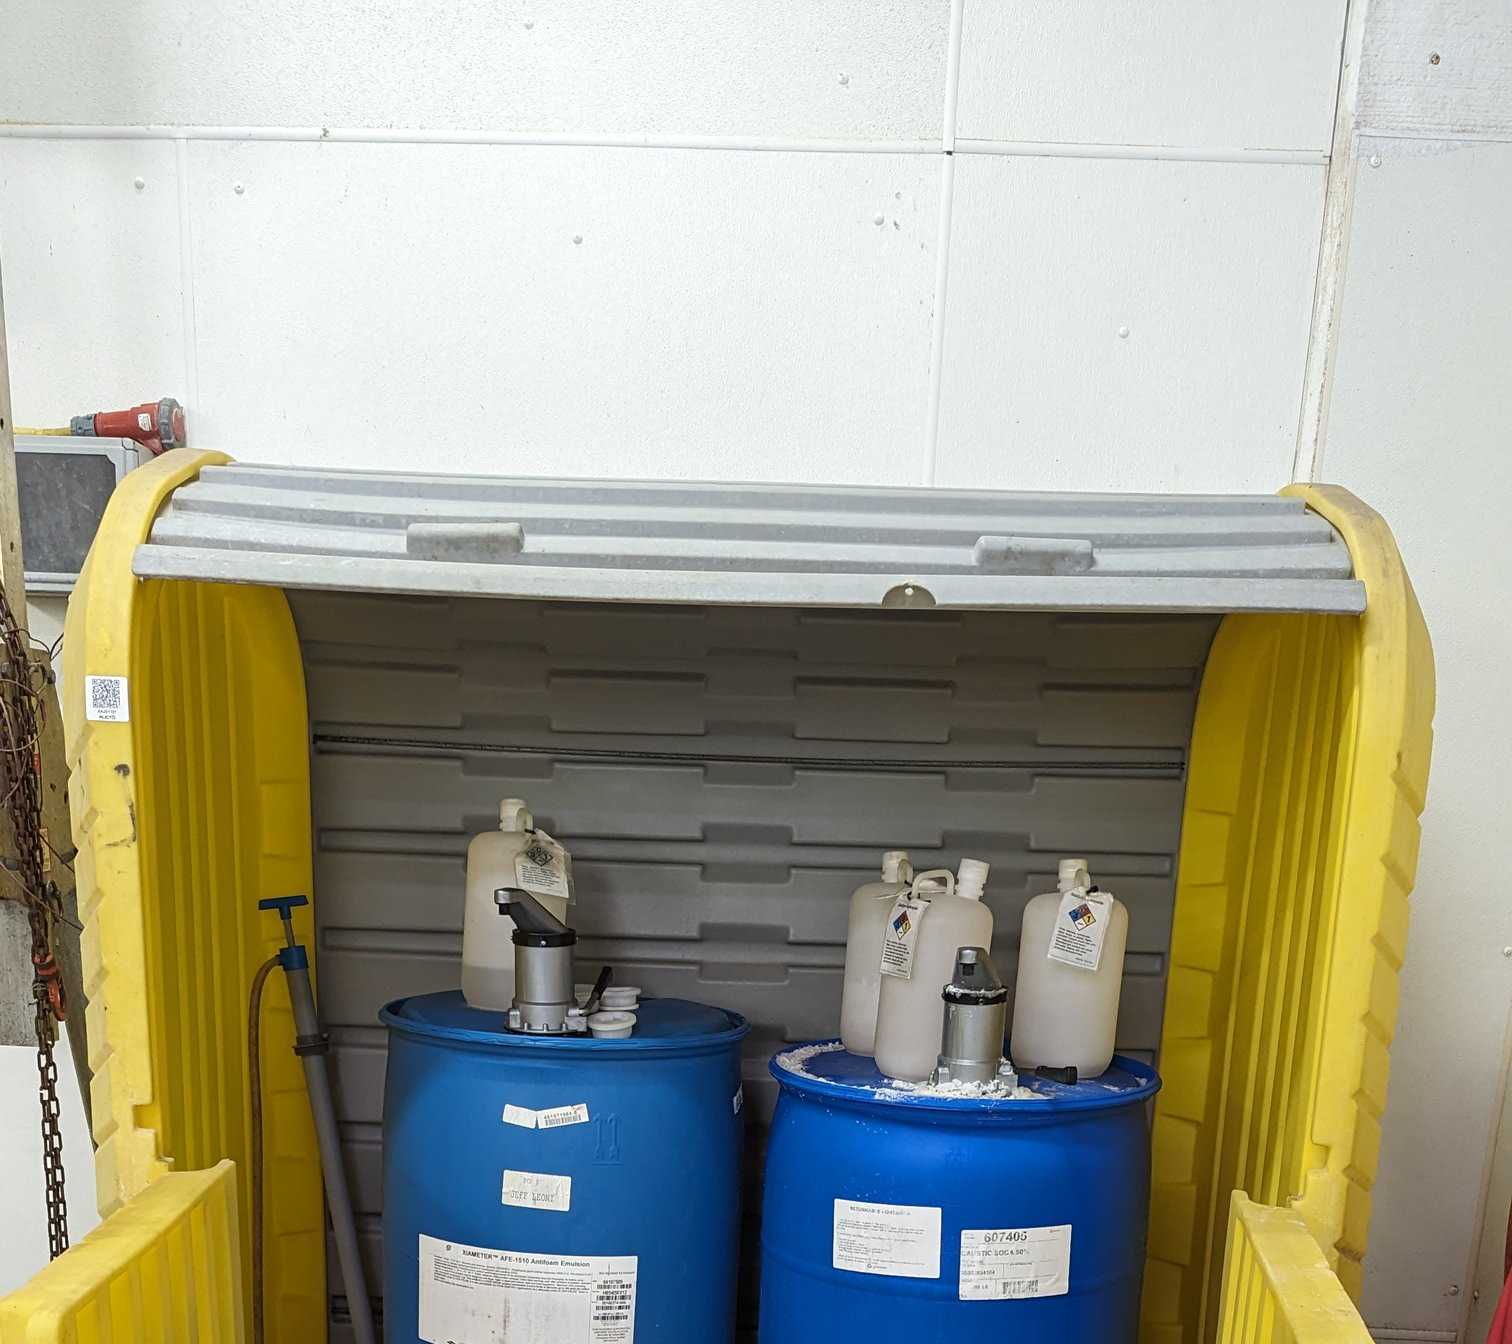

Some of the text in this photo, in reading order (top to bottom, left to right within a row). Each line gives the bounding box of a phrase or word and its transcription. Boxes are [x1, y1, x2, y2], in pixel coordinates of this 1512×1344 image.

[984, 1231, 1028, 1243] 607405
[499, 1255, 530, 1264] AFE-1510
[530, 1258, 559, 1266] Antifoam
